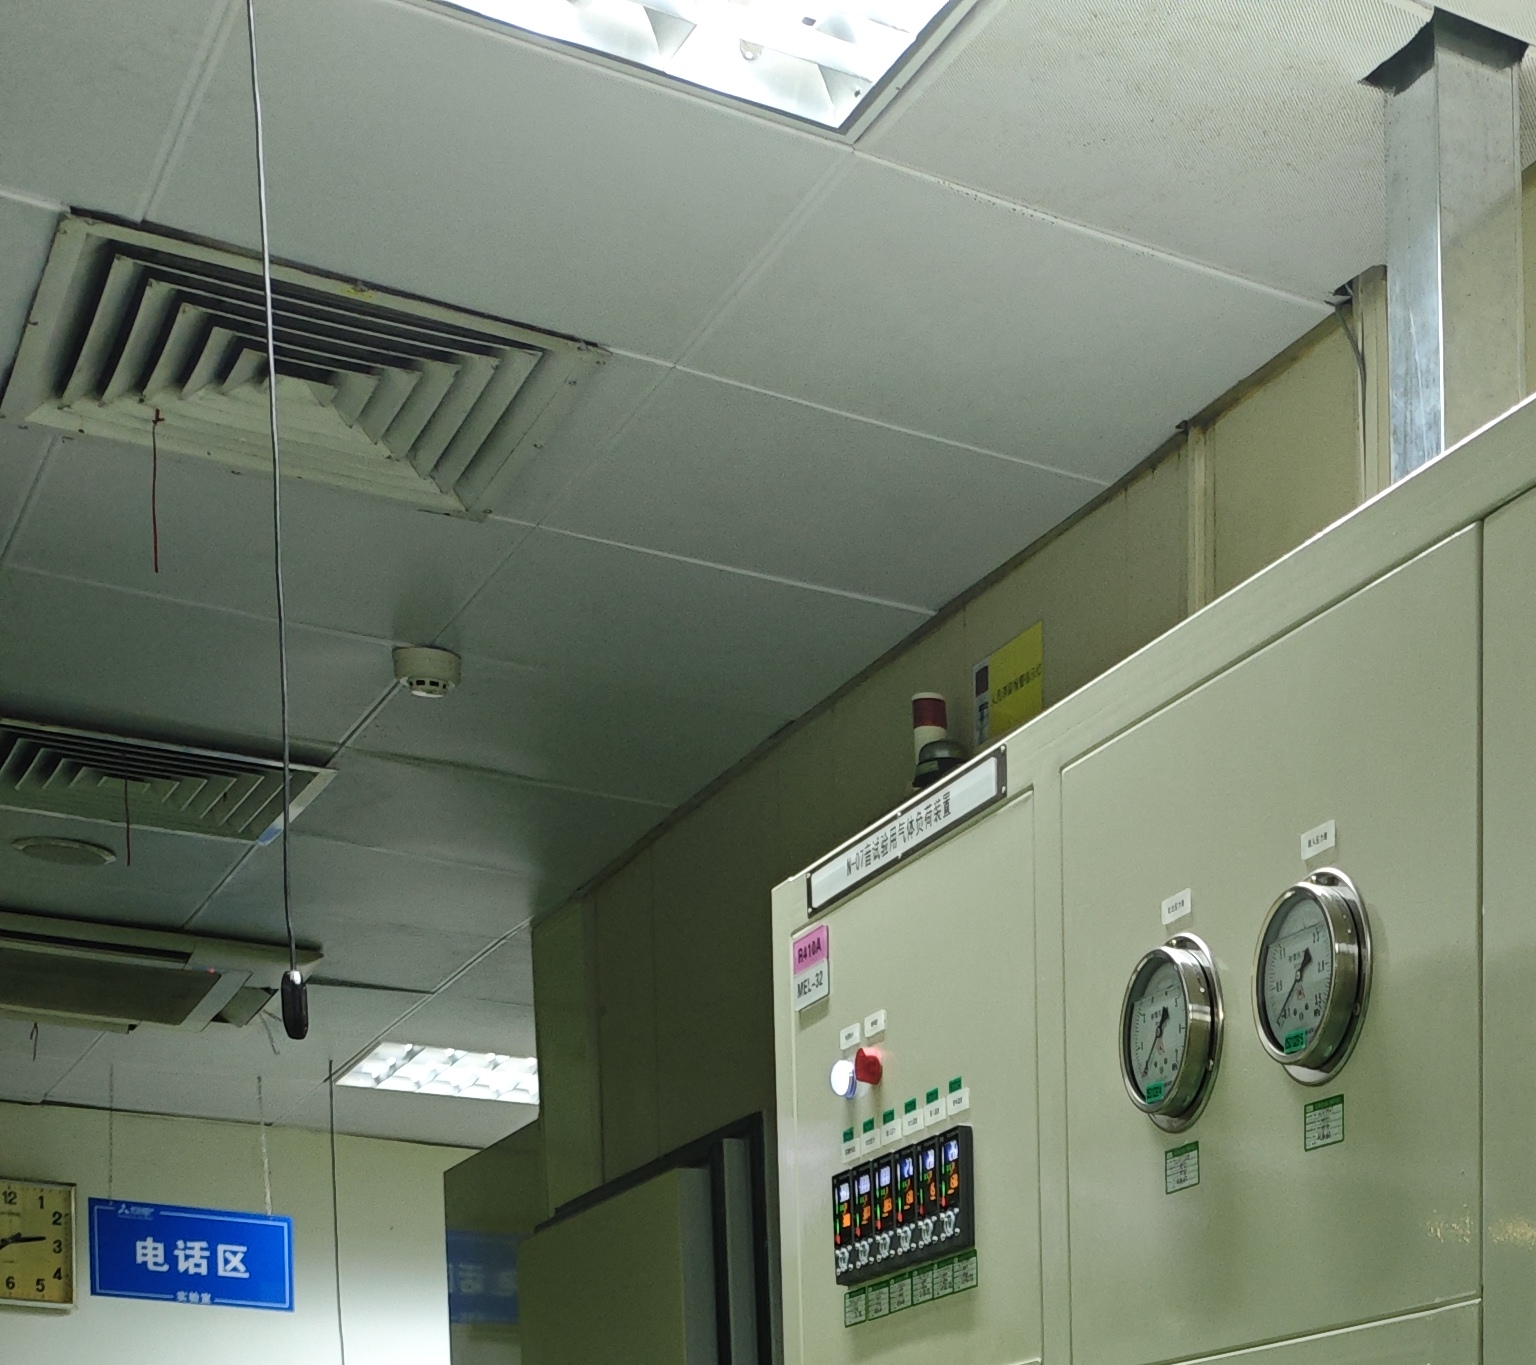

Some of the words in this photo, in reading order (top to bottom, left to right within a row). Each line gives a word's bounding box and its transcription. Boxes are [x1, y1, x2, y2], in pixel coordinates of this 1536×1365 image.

[798, 935, 821, 964] R410A
[797, 969, 822, 998] MEL-32
[2, 1190, 17, 1205] 12
[38, 1196, 45, 1209] 1
[52, 1212, 62, 1226] 2
[53, 1240, 63, 1254] 3
[135, 1236, 250, 1279] 电话区
[52, 1267, 63, 1281] 4
[5, 1276, 15, 1290] 6
[35, 1279, 46, 1293] 5
